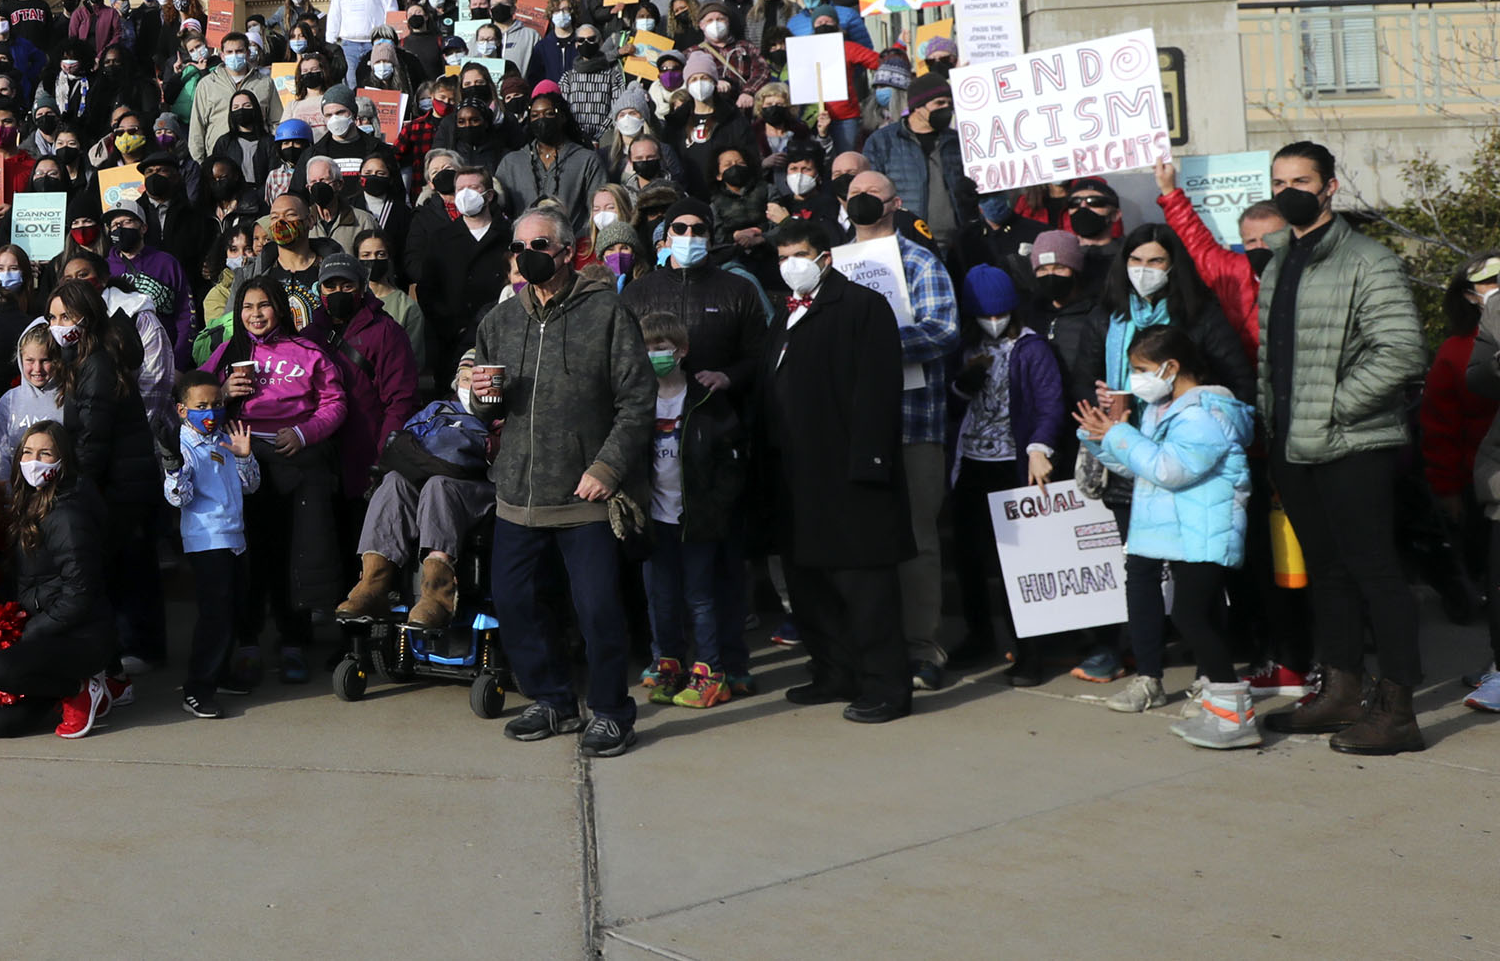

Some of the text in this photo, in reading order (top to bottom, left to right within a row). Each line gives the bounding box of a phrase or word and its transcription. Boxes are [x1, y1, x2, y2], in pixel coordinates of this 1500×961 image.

[10, 8, 46, 25] UTAH
[991, 48, 1104, 103] END
[959, 85, 1162, 163] RACISM
[1186, 173, 1263, 188] CANNOT
[16, 210, 62, 219] CANNOT
[15, 223, 61, 234] LOVE
[840, 260, 867, 273] UTAH
[1004, 490, 1085, 521] EQUAL
[1018, 562, 1118, 603] HUMAN
